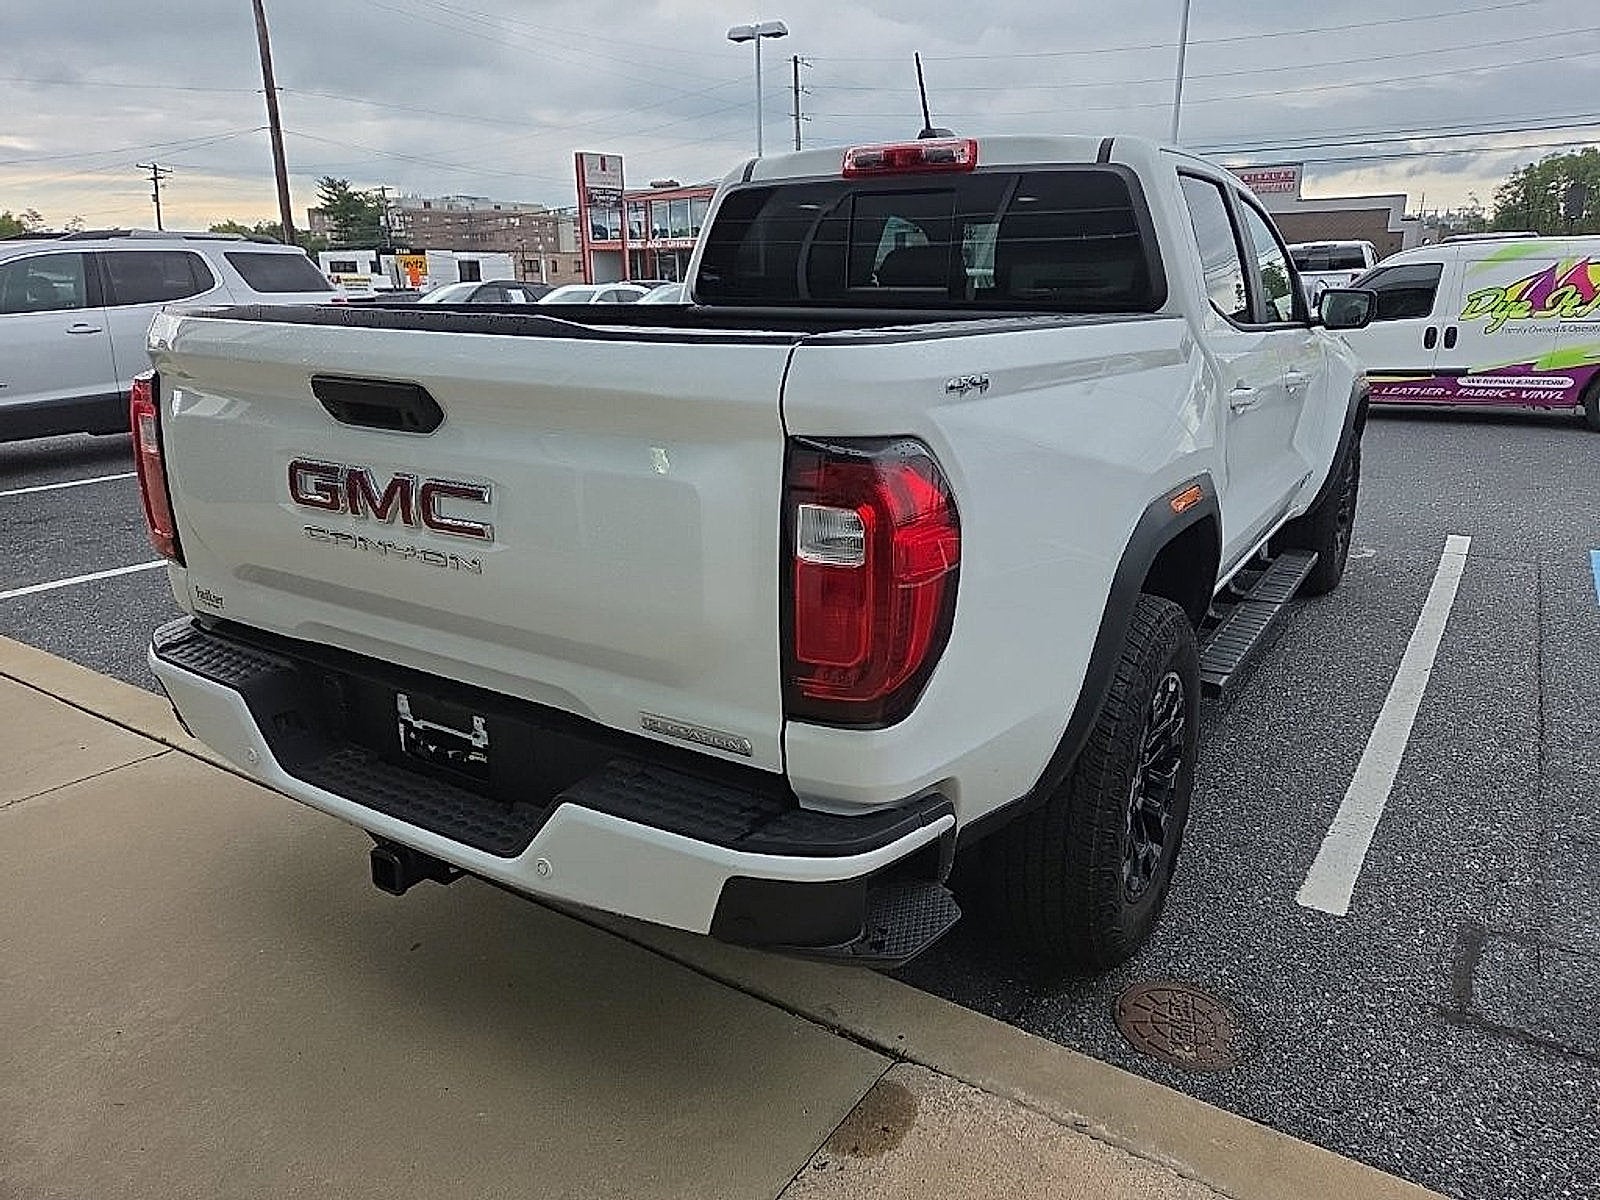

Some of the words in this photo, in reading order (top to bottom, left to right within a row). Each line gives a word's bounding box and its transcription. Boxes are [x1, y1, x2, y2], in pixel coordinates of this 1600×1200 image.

[667, 240, 692, 248] OFFICE
[1458, 287, 1534, 335] Dye
[1381, 387, 1446, 396] LEATHER
[1455, 388, 1511, 398] FABRIC
[1521, 390, 1565, 400] VINYL
[287, 456, 495, 543] GMC
[303, 525, 483, 575] CANYON
